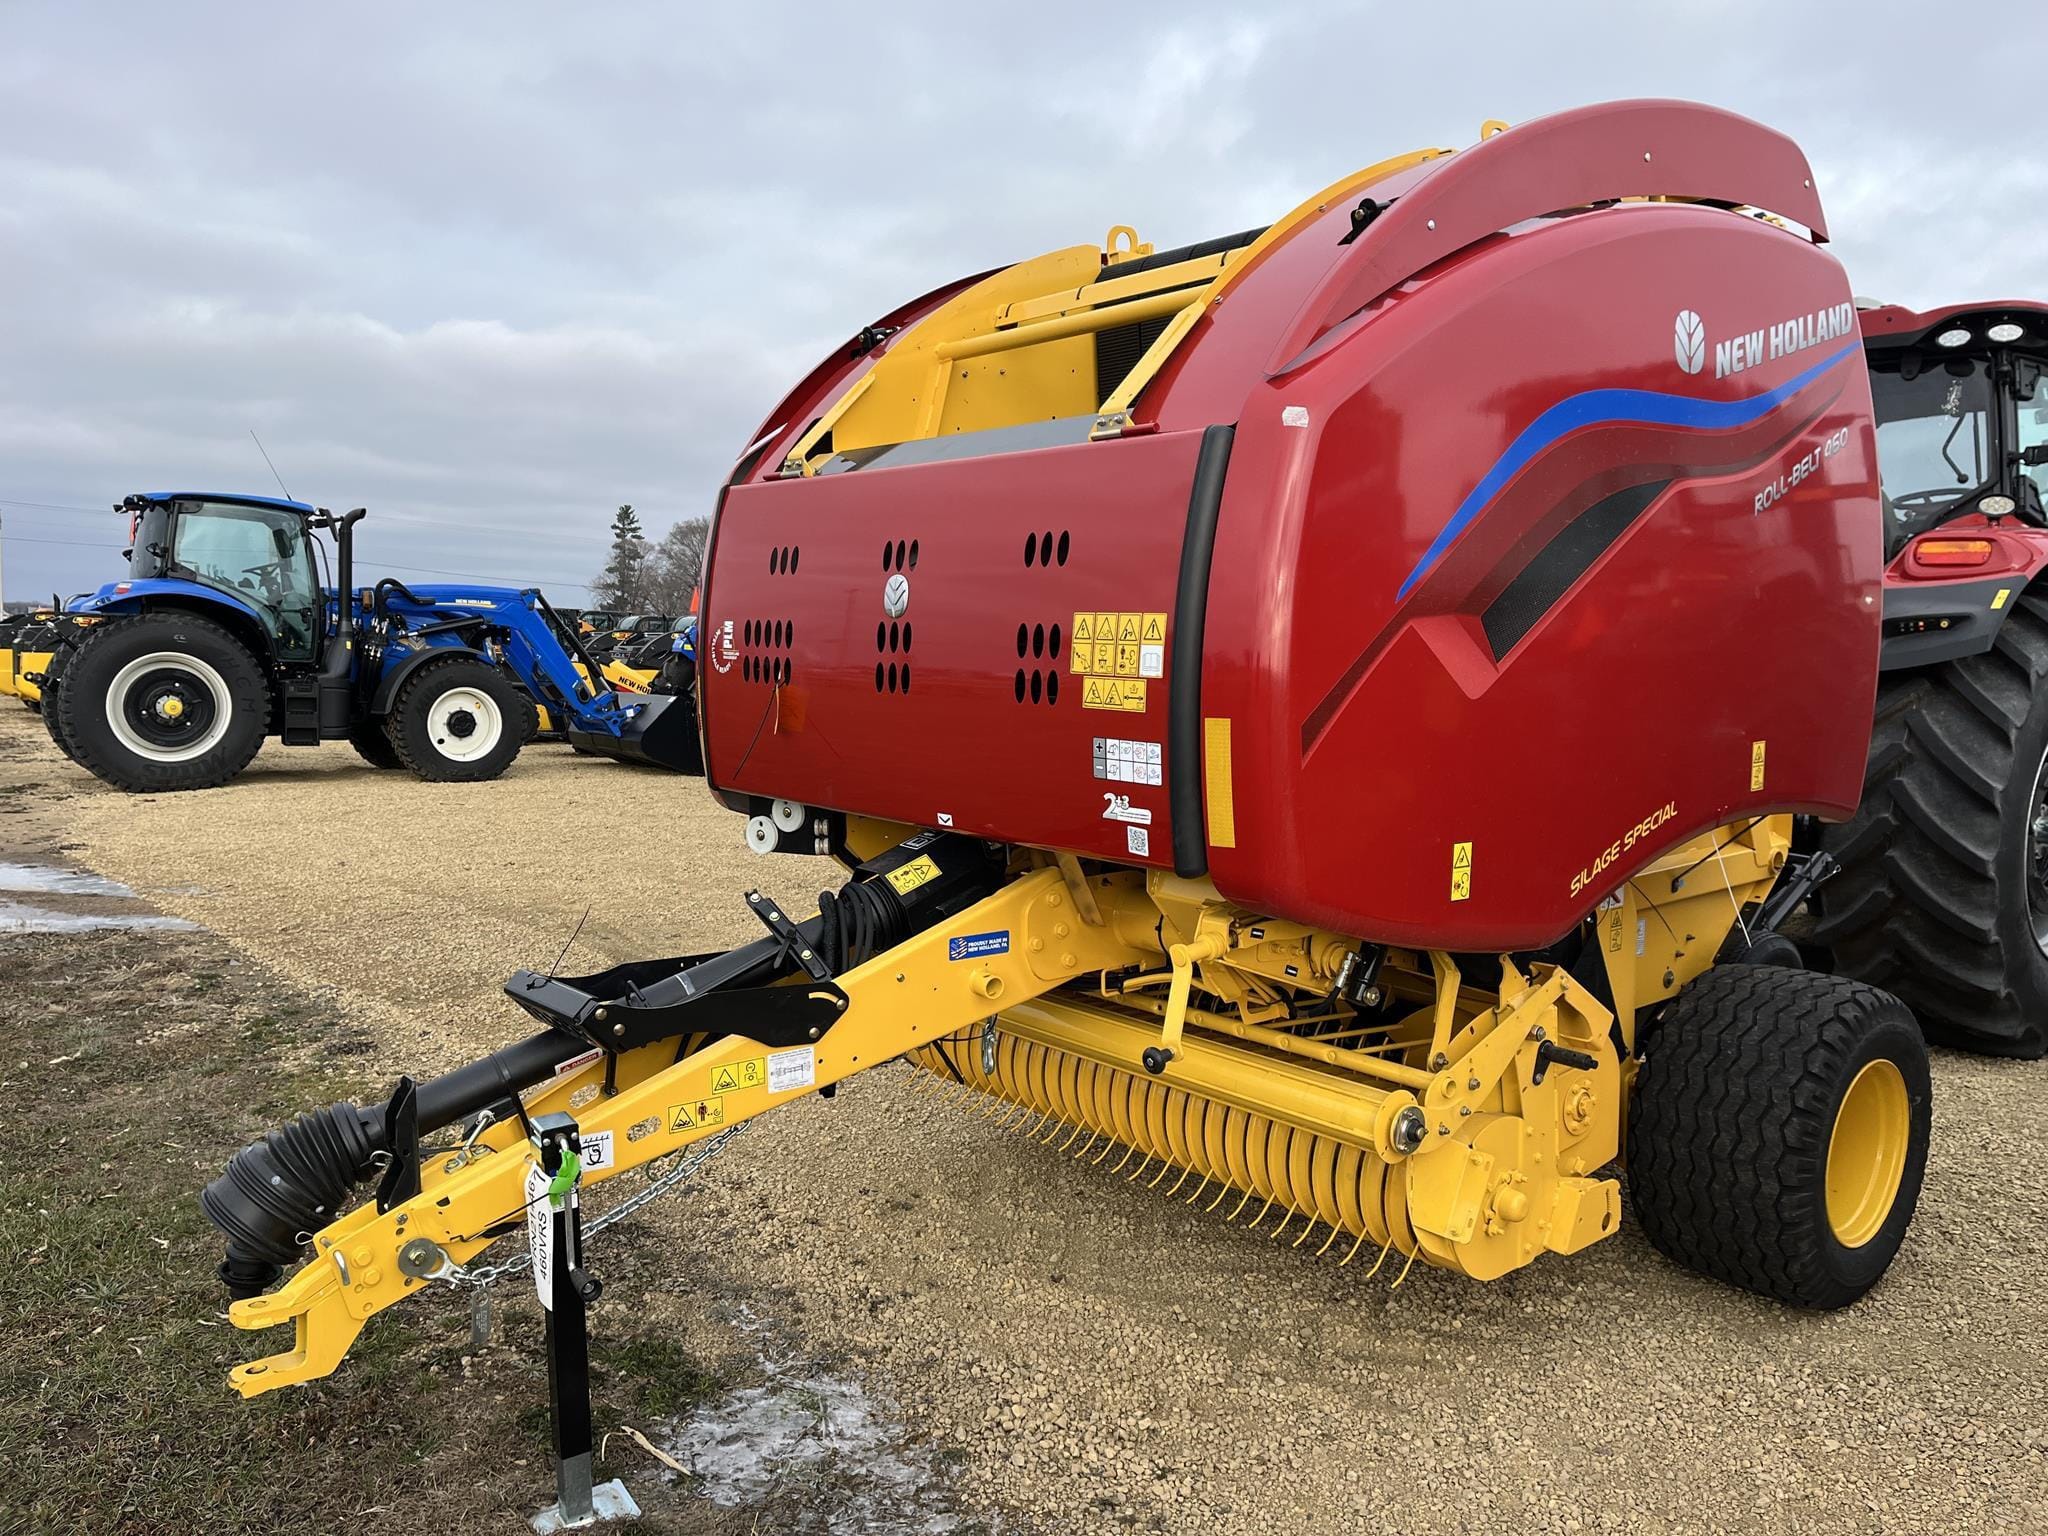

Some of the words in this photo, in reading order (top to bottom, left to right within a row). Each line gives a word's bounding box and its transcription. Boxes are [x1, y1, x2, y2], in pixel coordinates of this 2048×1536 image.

[1715, 328, 1765, 380] NEW
[1769, 302, 1853, 360] HOLLAND
[1754, 446, 1822, 517] ROLL-BELT
[1824, 426, 1849, 457] 460
[722, 620, 734, 649] PLM
[618, 675, 637, 689] NEW
[1570, 839, 1621, 899] SILAGE
[1623, 800, 1678, 852] SPECIAL
[537, 1210, 548, 1280] 460VRS
